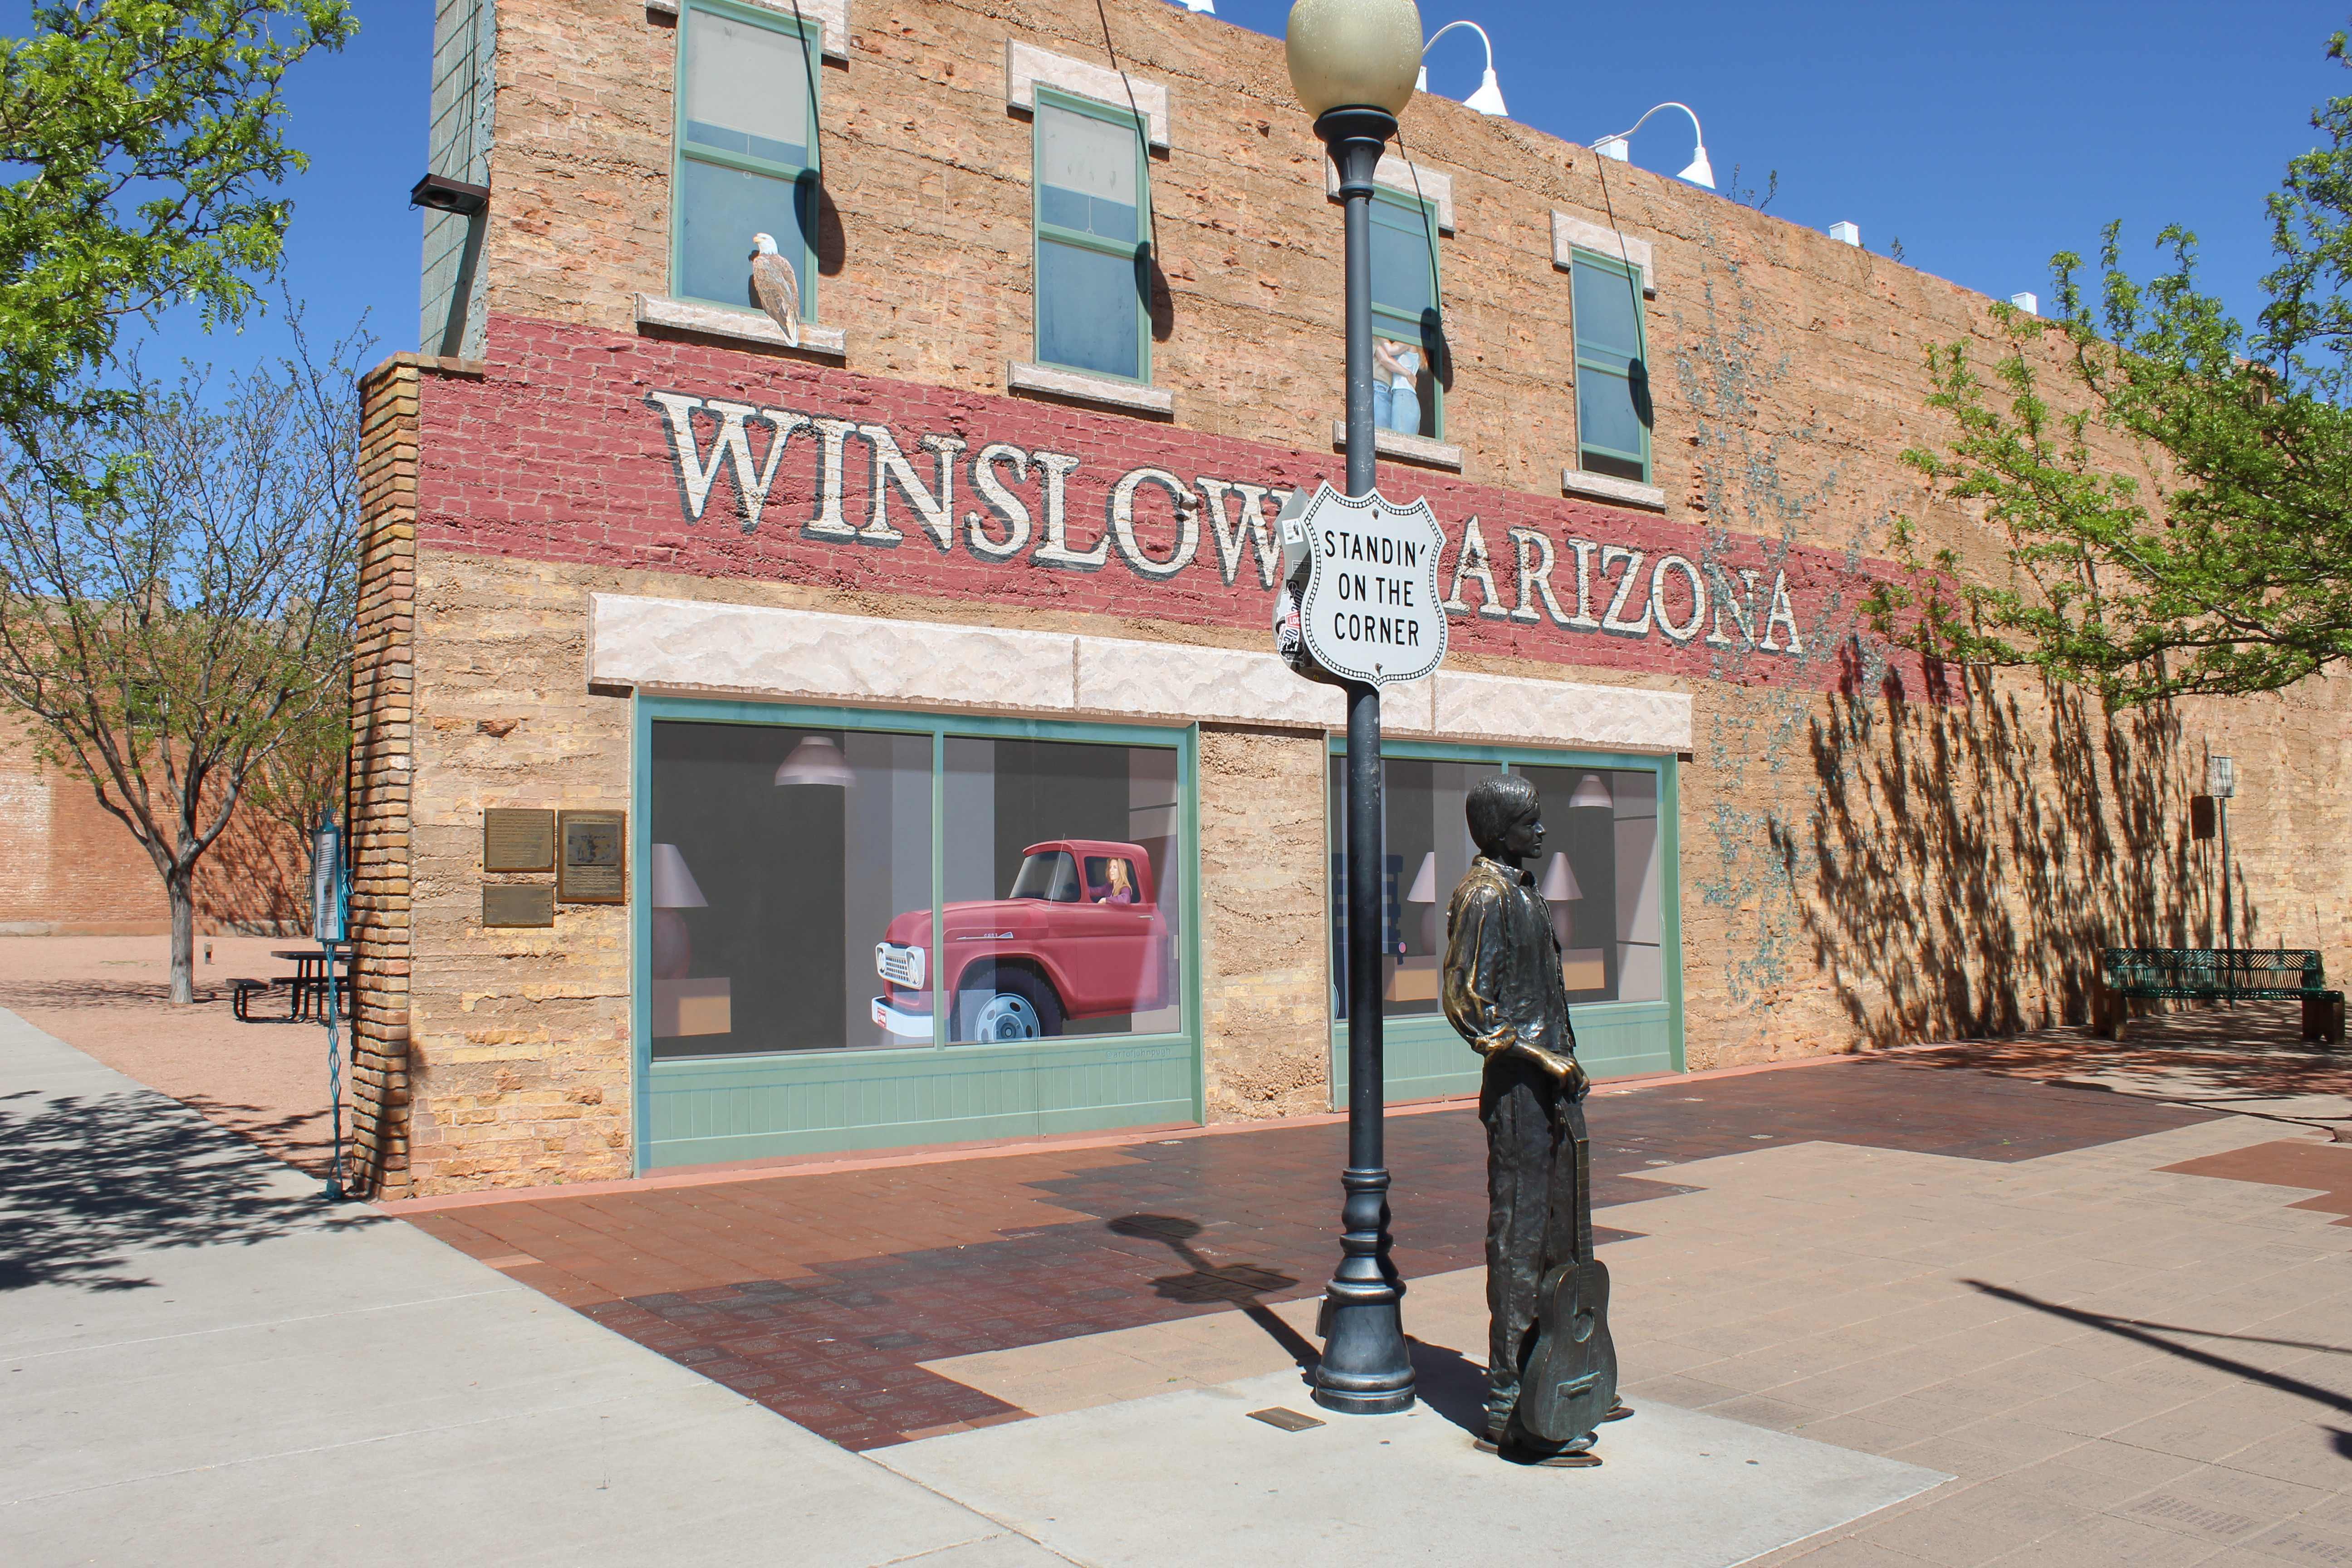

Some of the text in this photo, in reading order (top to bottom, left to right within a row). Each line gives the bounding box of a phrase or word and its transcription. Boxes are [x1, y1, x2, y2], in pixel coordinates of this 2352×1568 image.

[1325, 530, 1426, 568] STANDIN'
[1338, 573, 1366, 602] ON
[1376, 577, 1414, 607] THE
[1443, 514, 1804, 654] ARIZONA
[1334, 612, 1419, 647] CORNER
